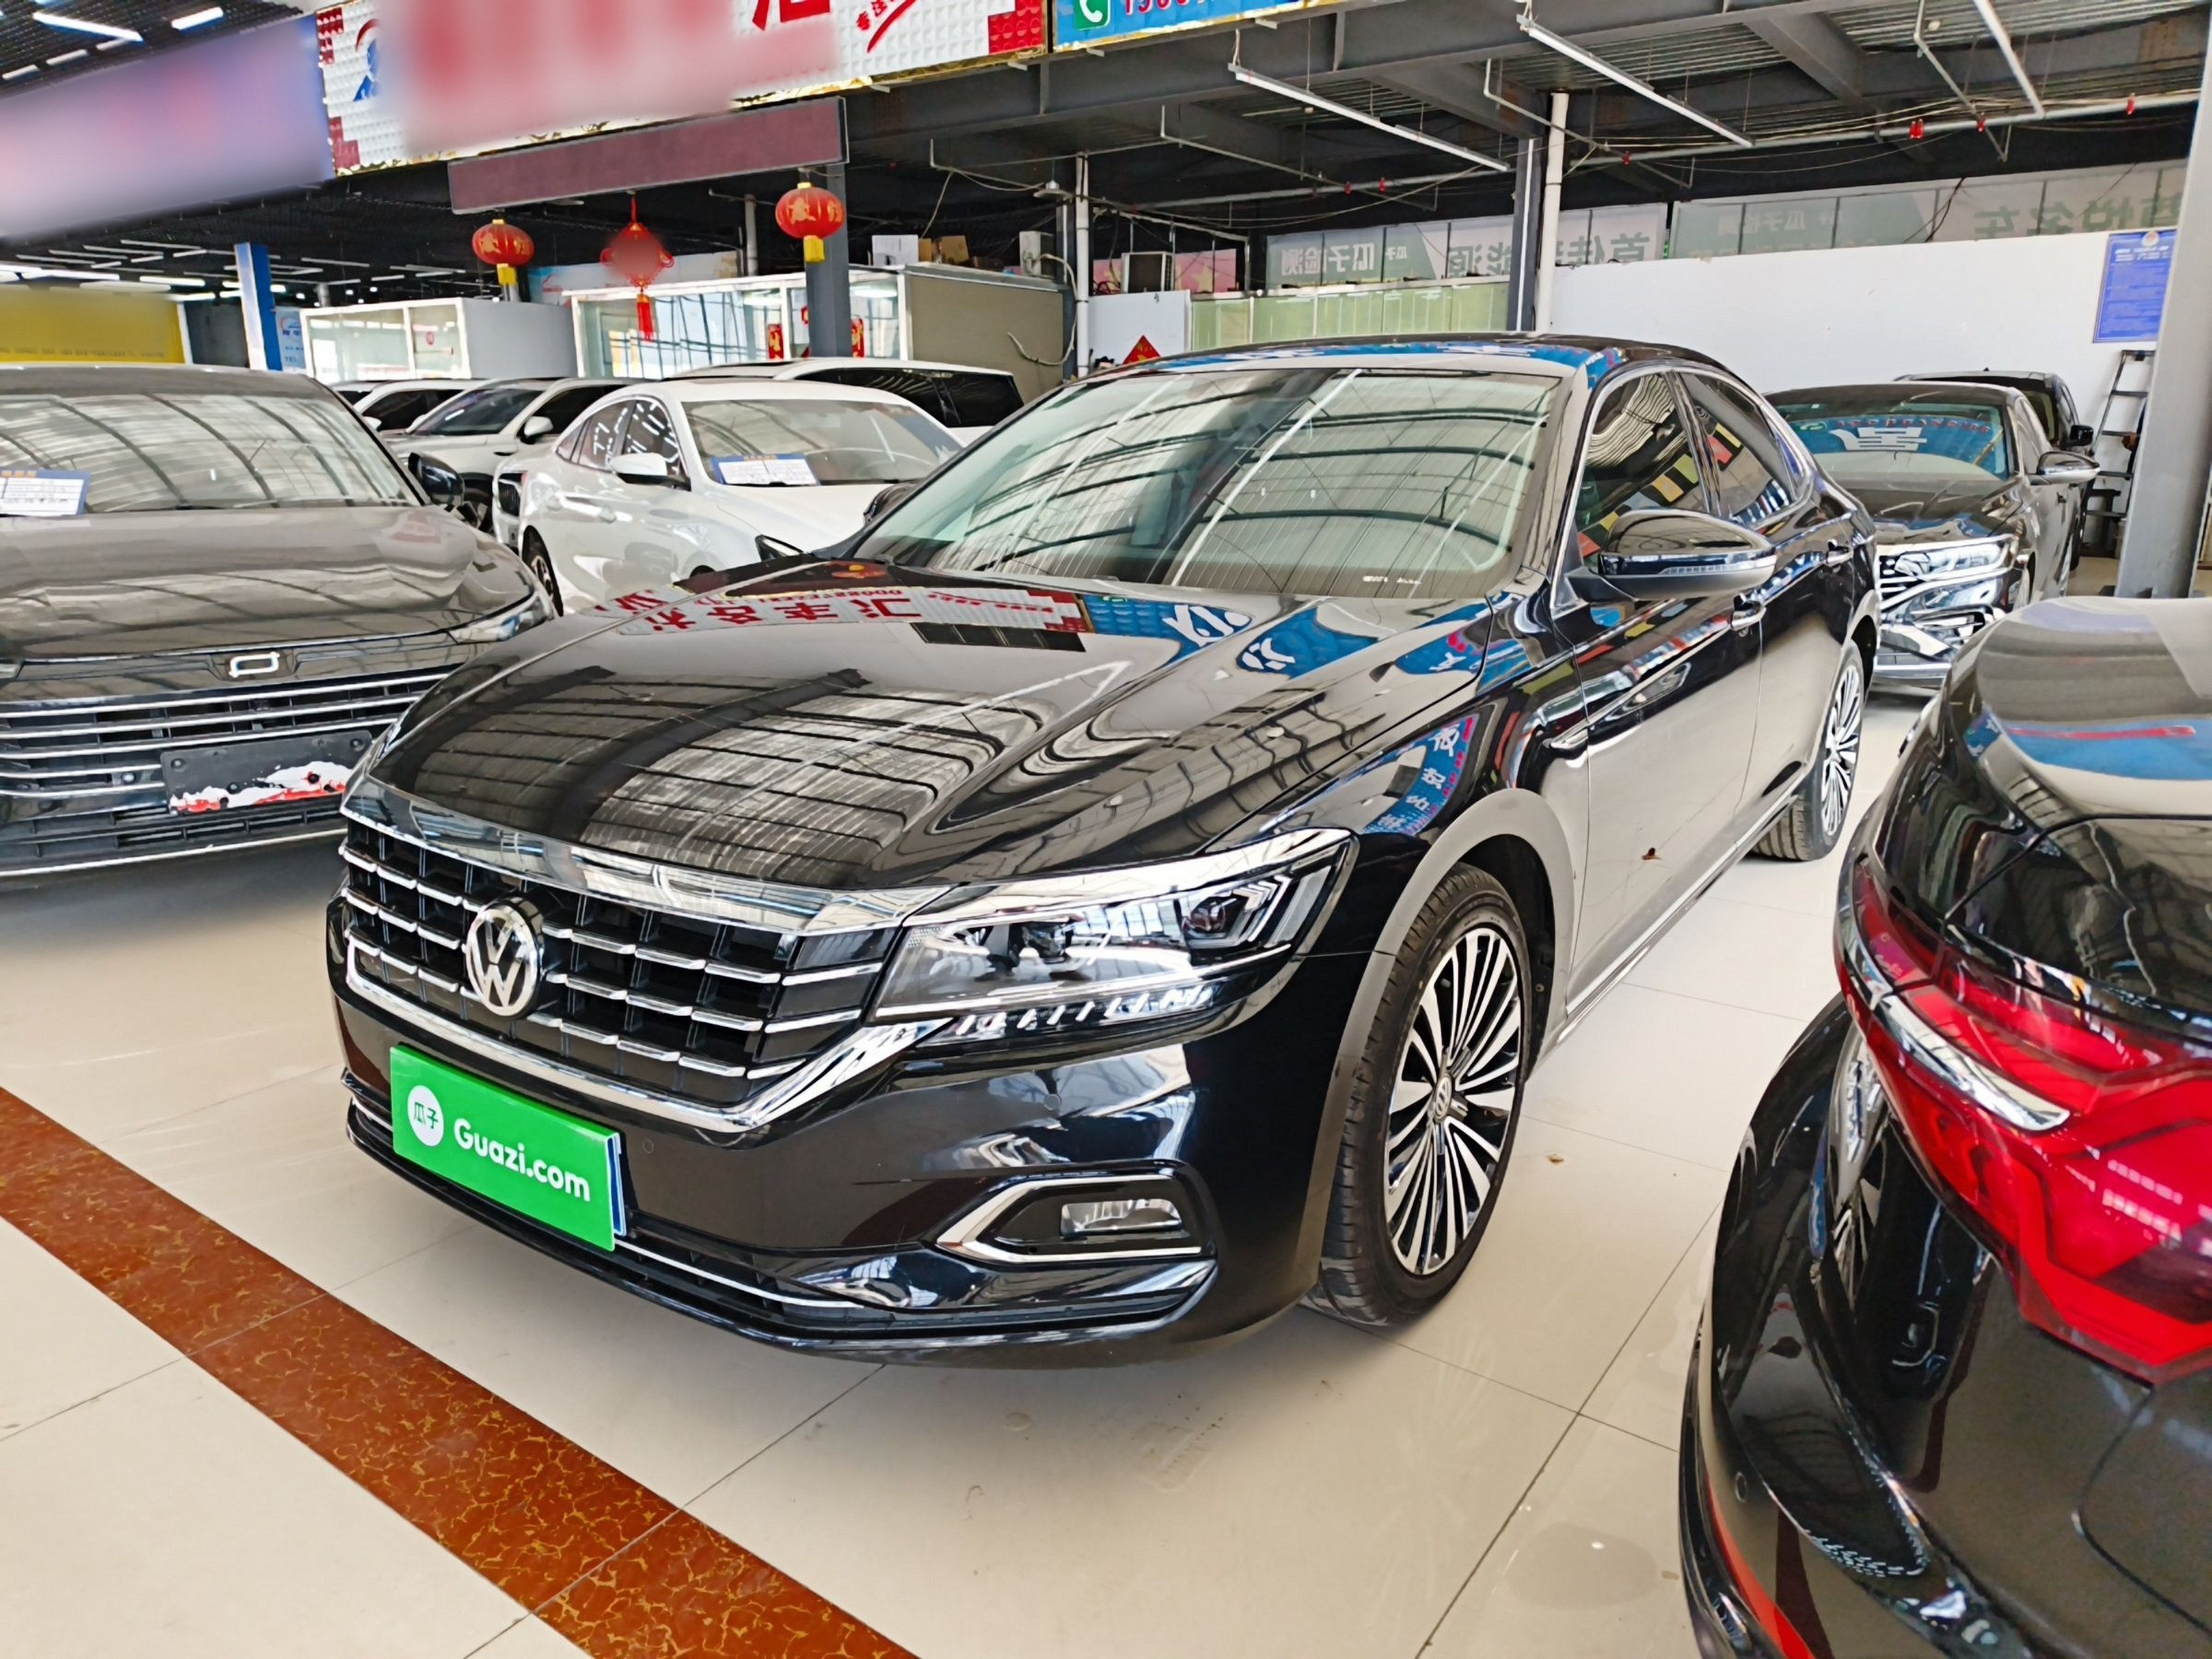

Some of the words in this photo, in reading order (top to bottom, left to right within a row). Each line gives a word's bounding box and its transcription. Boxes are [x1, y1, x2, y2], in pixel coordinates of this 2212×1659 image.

[469, 908, 535, 1013] VW
[414, 1101, 438, 1129] 瓜子
[454, 1118, 591, 1202] Guazi.com
